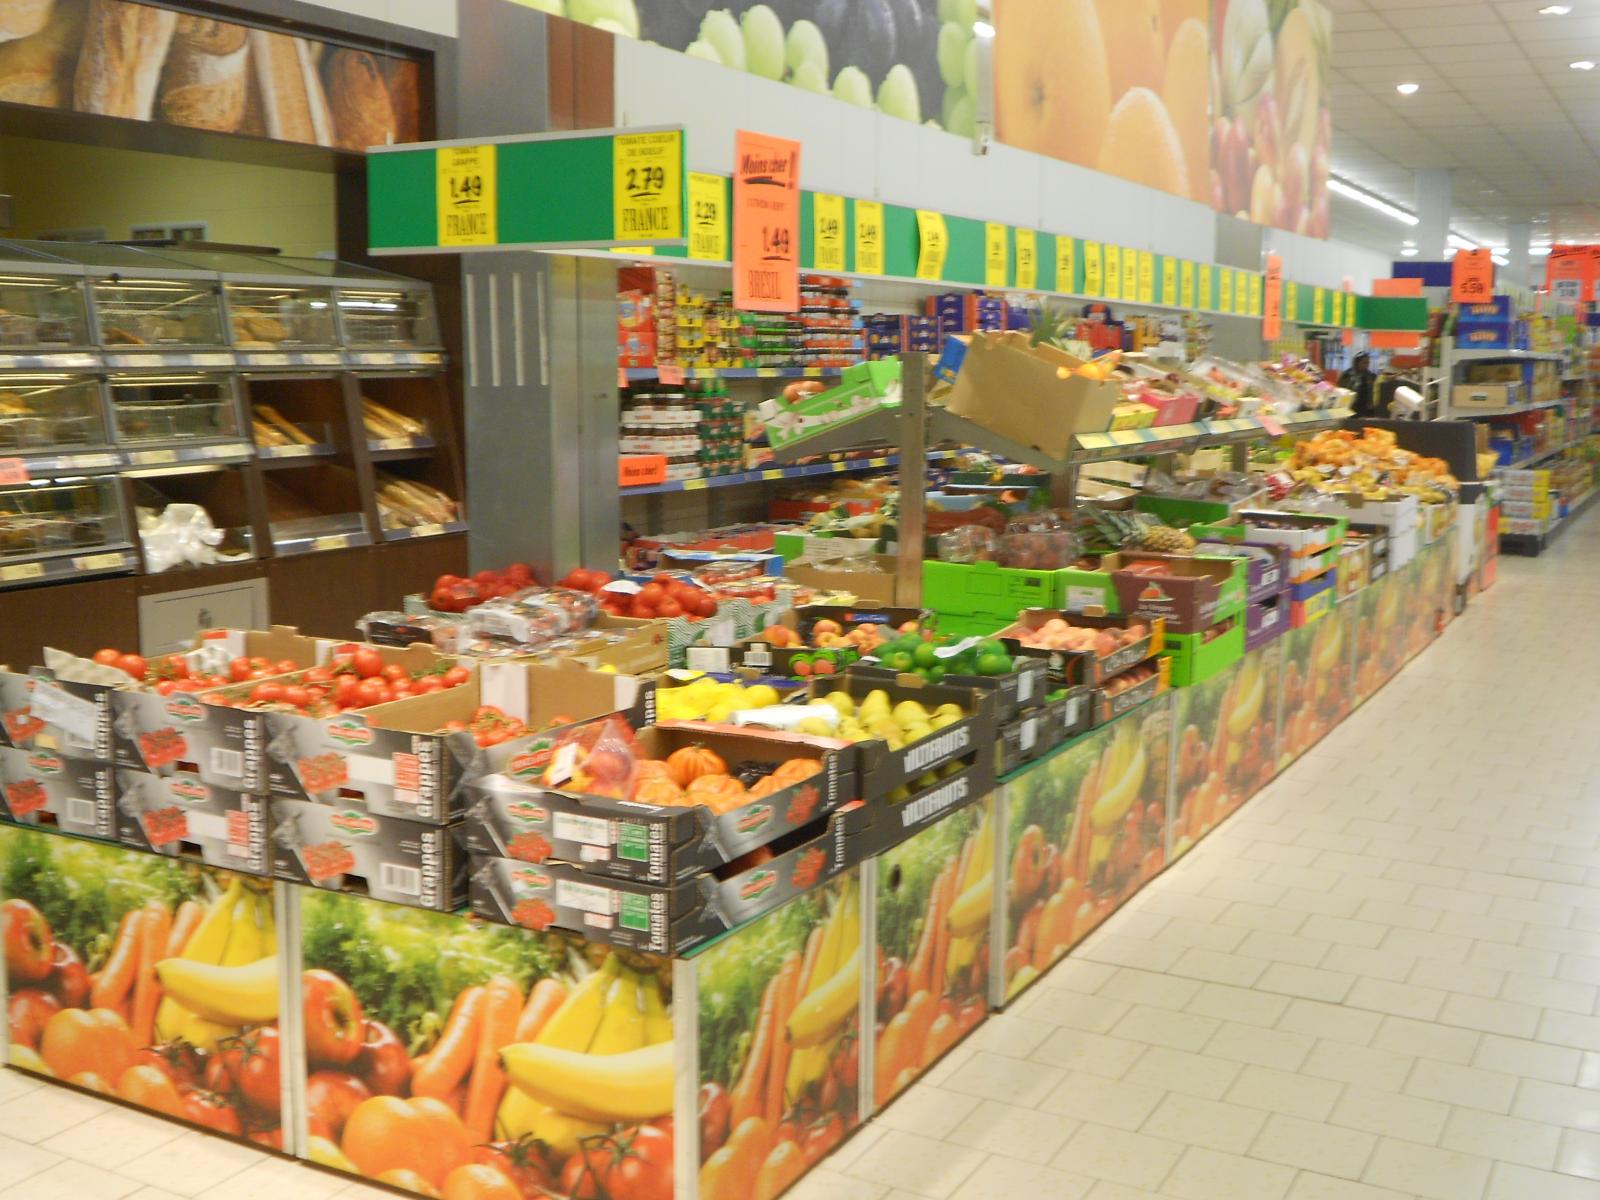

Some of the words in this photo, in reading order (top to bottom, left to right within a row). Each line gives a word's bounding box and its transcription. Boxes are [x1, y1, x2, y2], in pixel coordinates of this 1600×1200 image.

[741, 153, 768, 174] Moins
[448, 175, 482, 198] 1.49
[625, 166, 664, 191] 2.79
[446, 213, 487, 236] FRANCE
[623, 206, 669, 231] FRANCE
[761, 226, 790, 253] 1.49
[417, 740, 437, 818] Grappes
[648, 822, 667, 882] Tomates
[419, 831, 440, 908] Grappes
[648, 893, 668, 953] Tomates
